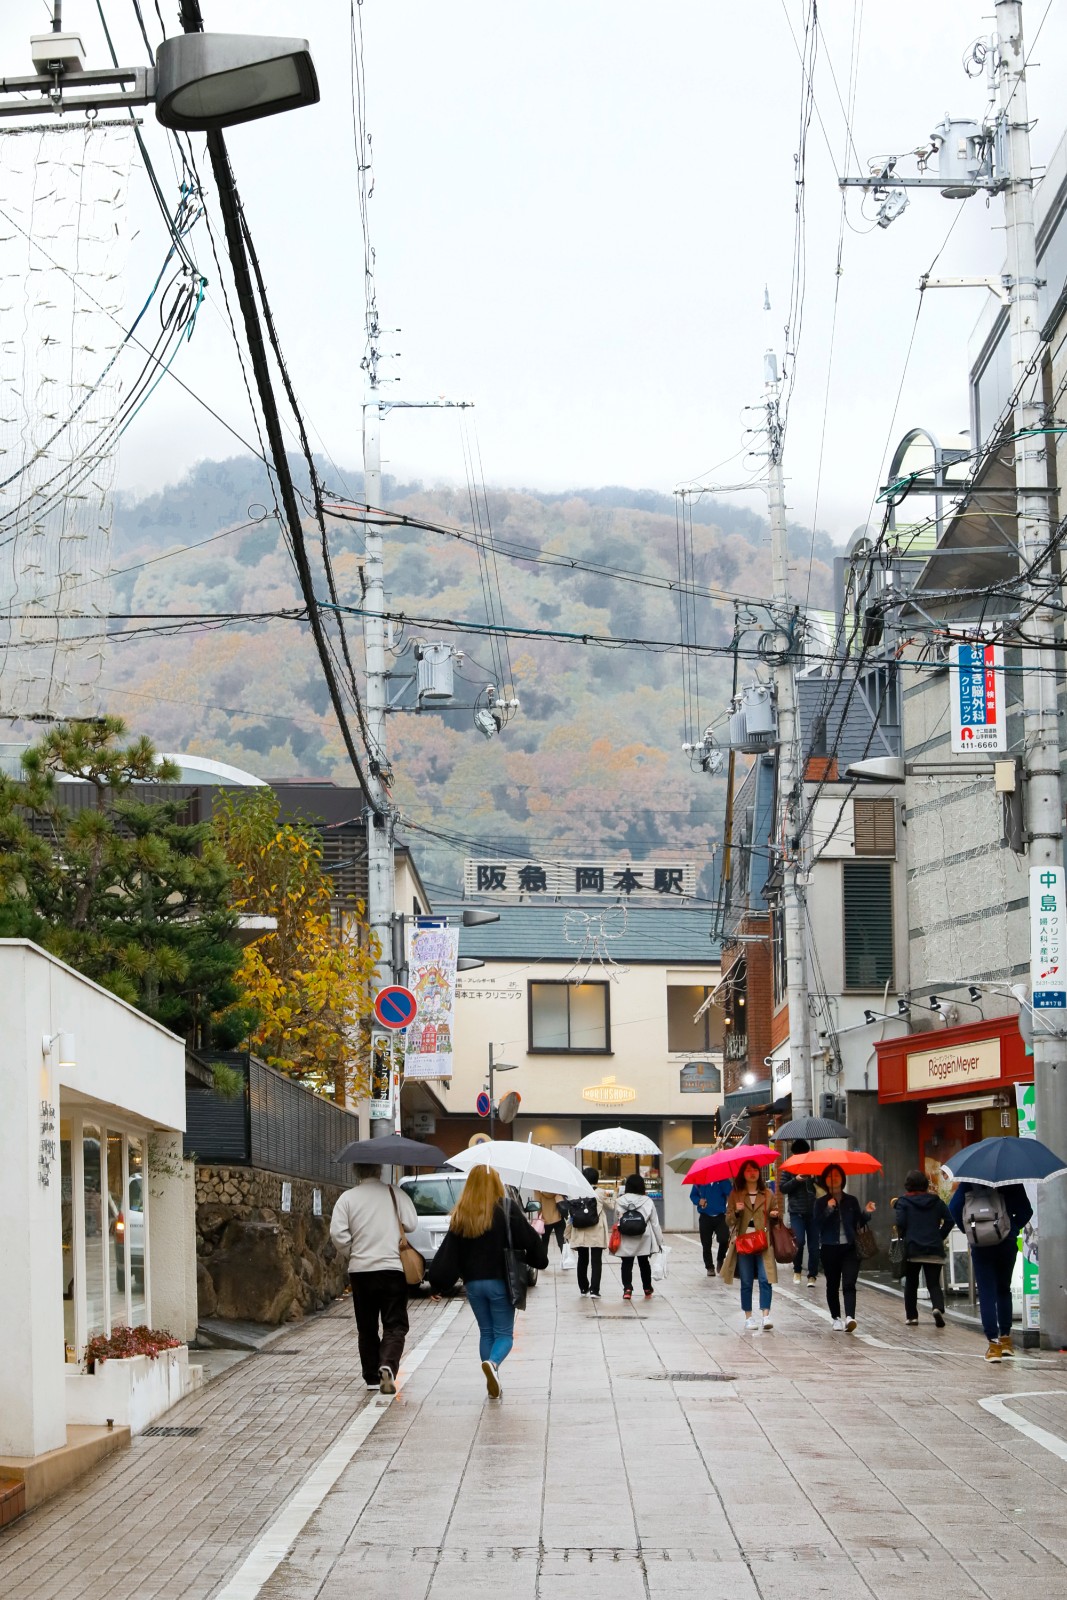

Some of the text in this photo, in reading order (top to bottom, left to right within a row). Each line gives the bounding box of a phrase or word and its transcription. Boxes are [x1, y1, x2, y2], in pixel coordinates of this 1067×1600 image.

[961, 676, 971, 723] クリニック
[961, 741, 998, 749] 411-6660
[477, 865, 684, 894] 阪急 岡本駅
[1040, 871, 1057, 912] 中島
[1051, 917, 1059, 963] クリニック
